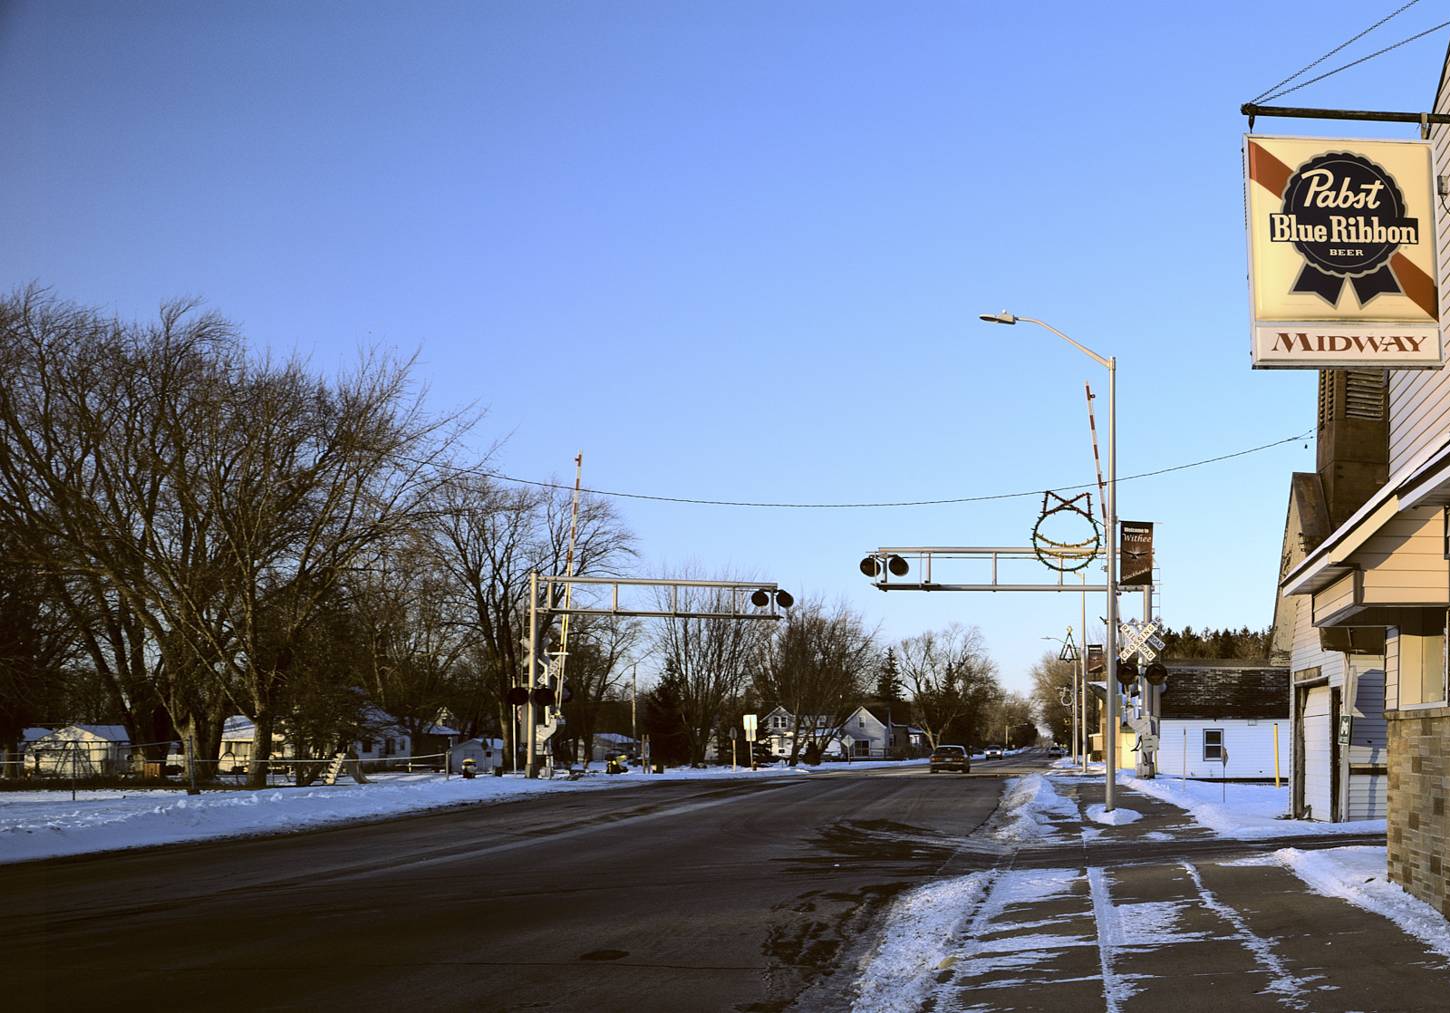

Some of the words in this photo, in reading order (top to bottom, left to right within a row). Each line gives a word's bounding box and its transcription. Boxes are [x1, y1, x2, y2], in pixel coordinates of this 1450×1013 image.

[1301, 168, 1384, 209] Pabst
[1271, 214, 1327, 242] Blue
[1329, 215, 1418, 244] Ribbon
[1329, 249, 1364, 257] BEER
[1272, 332, 1428, 353] MIDWAY
[1122, 533, 1152, 543] Withee
[1121, 624, 1155, 659] CROSSING
